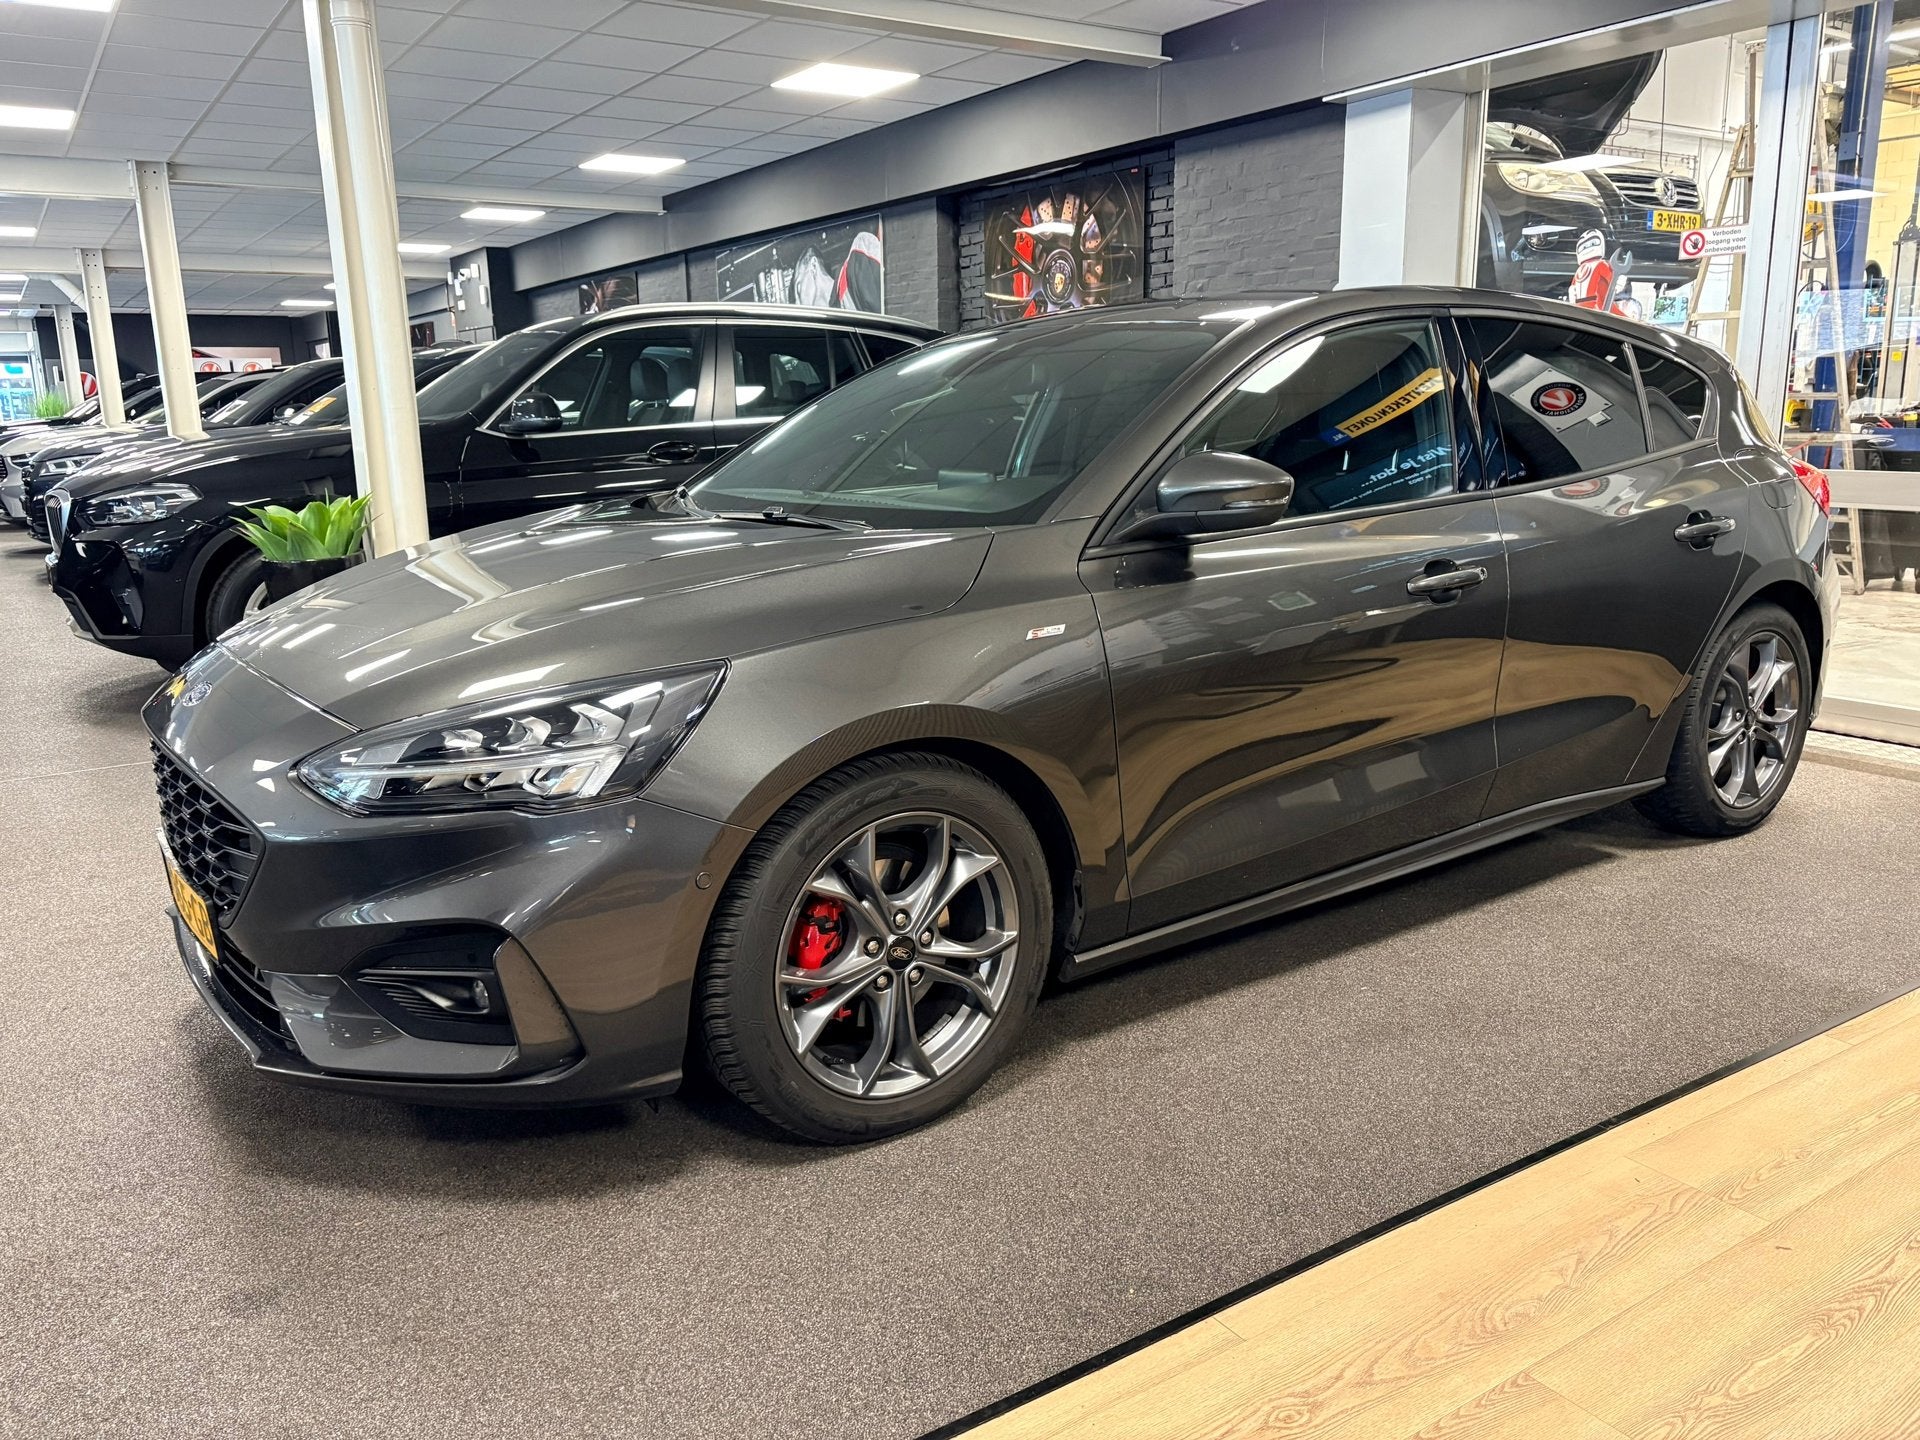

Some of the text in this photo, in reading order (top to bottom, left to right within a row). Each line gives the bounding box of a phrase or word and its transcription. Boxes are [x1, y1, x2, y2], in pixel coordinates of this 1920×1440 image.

[1657, 213, 1697, 229] 3-XHR-19
[1705, 238, 1731, 246] toegang
[1704, 245, 1746, 253] onbevoegden
